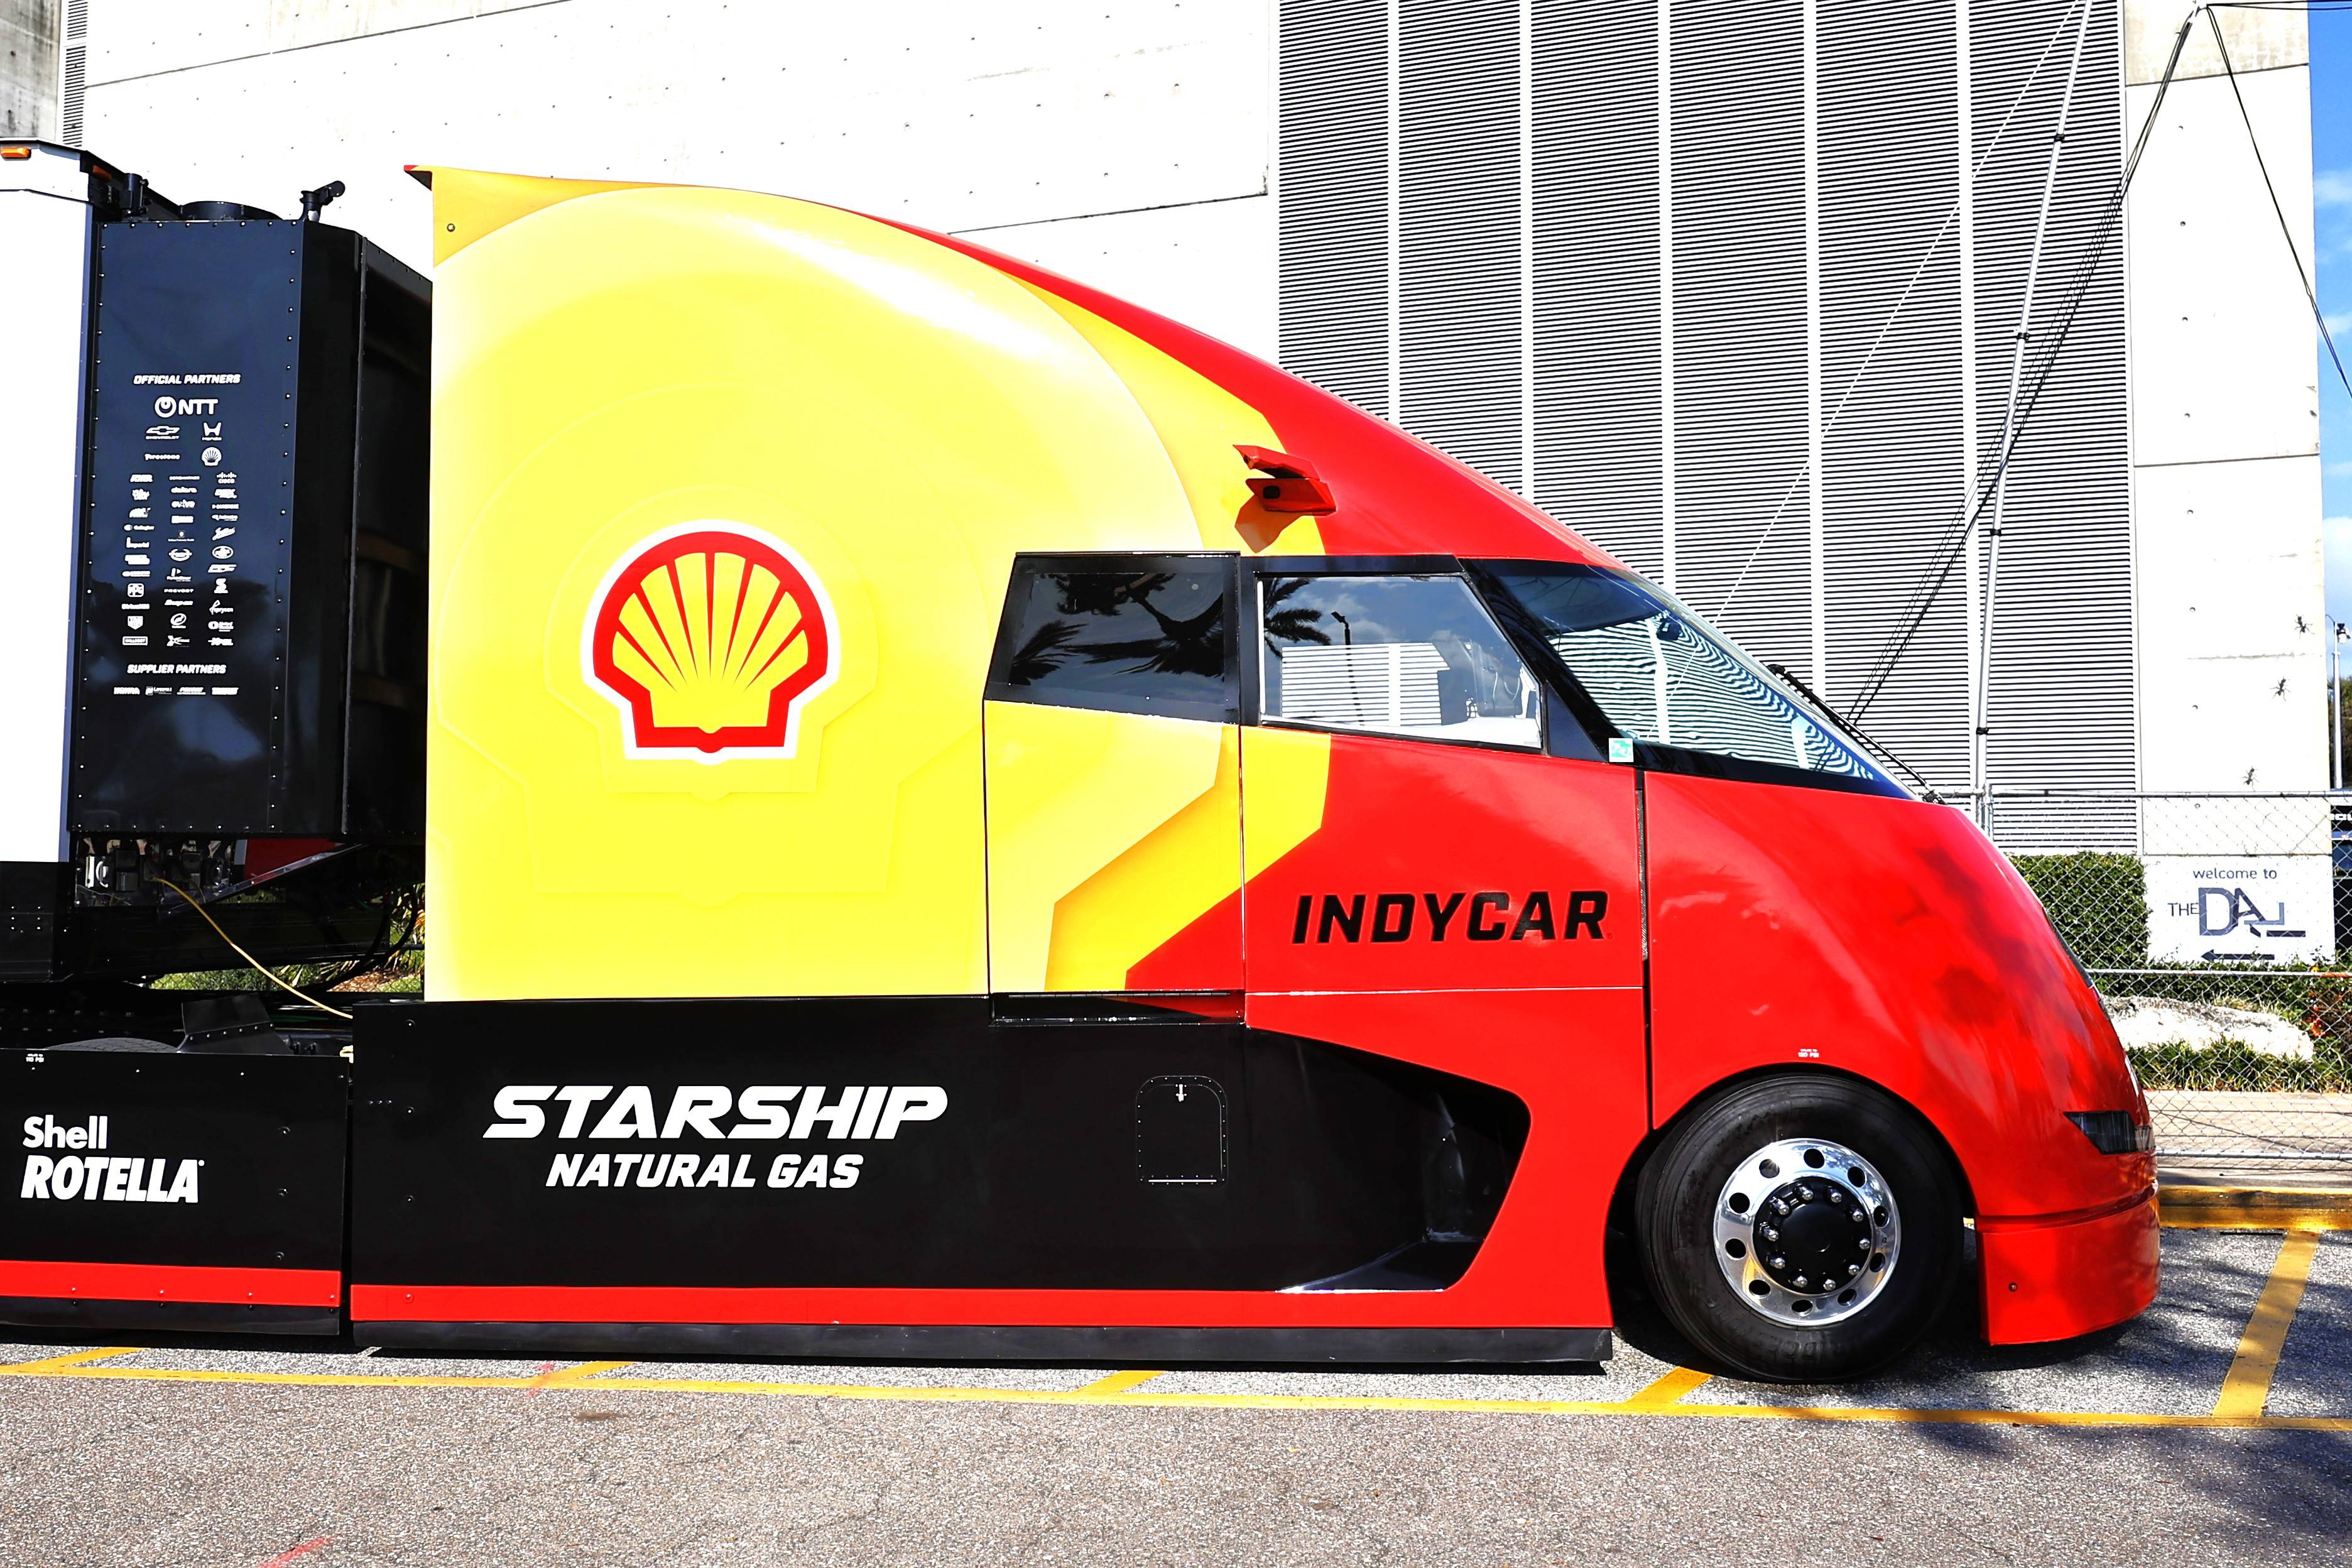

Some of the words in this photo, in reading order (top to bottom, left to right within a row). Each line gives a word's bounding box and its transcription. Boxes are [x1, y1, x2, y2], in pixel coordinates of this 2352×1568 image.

[134, 375, 182, 384] OFFICIAL
[184, 374, 241, 384] PARTNERS
[178, 400, 218, 415] NTT
[127, 664, 175, 673] SUPPLIER
[175, 664, 227, 673] PARTNERS
[2192, 868, 2257, 879] welcome
[2263, 868, 2277, 879] to
[1294, 892, 1606, 943] INDYCAR
[2167, 902, 2199, 917] THE
[483, 1086, 947, 1139] STARSHIP
[23, 1115, 107, 1148] Shell
[21, 1155, 198, 1202] ROTELLA
[546, 1154, 755, 1187] NATURAL
[768, 1155, 863, 1188] GAS
